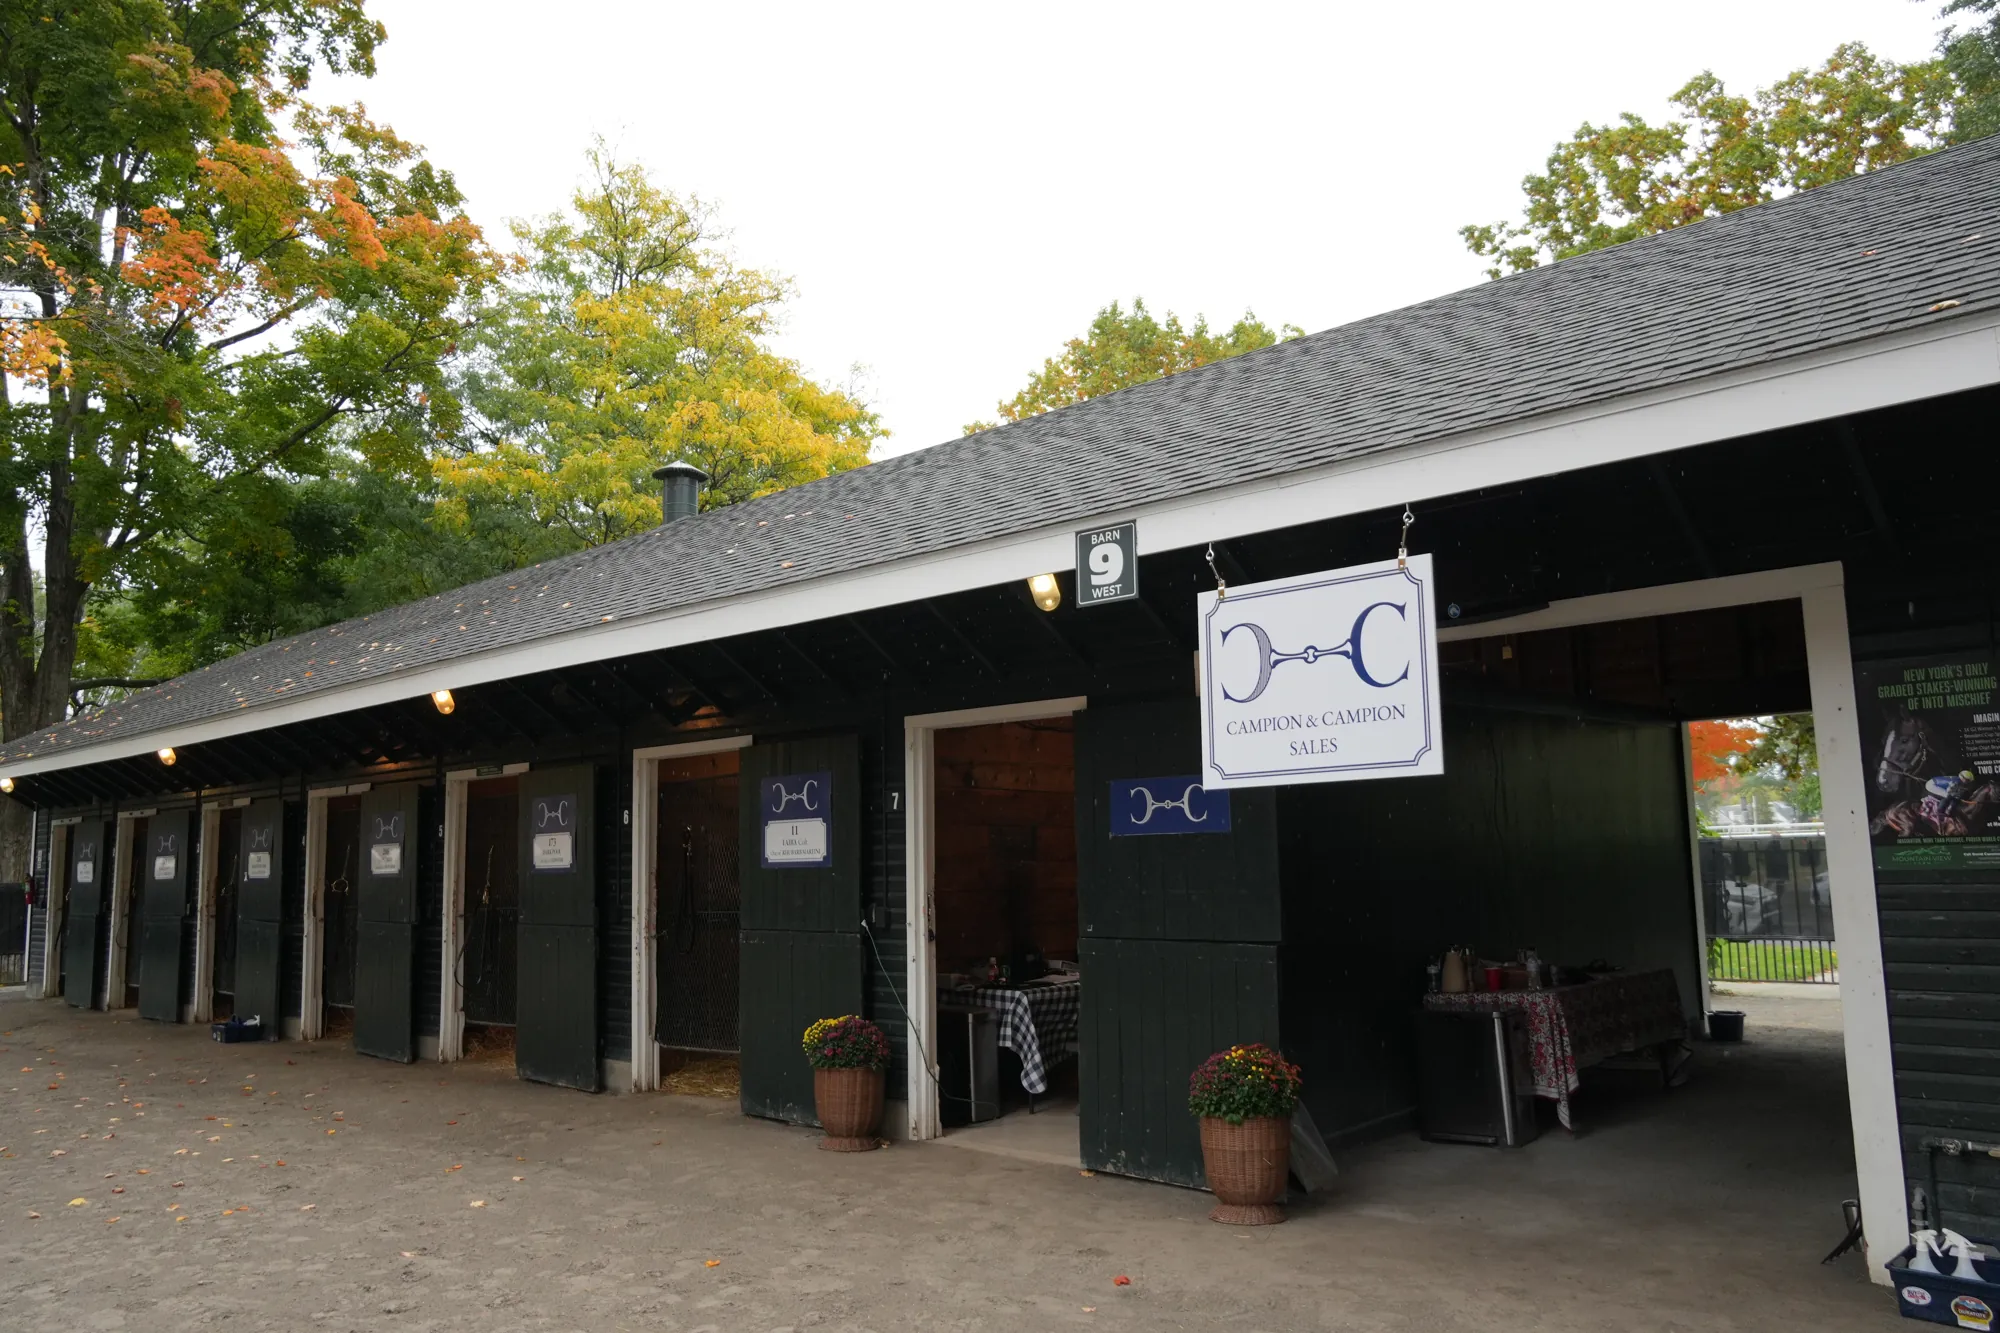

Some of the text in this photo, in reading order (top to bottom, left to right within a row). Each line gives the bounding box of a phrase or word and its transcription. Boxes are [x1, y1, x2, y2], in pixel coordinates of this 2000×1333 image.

[1091, 529, 1120, 544] BARN
[1089, 542, 1123, 585] 9
[1091, 584, 1122, 599] WEST
[1903, 662, 1988, 682] NEW YORK'S ONLY
[1878, 676, 1997, 698] GRADED STAKES-WINNING
[1908, 692, 1991, 710] OF INTO MISCHIEF
[1226, 704, 1406, 736] CAMPION & CAMPION
[1290, 738, 1338, 756] SALES
[1977, 765, 1993, 775] TWO
[891, 792, 899, 810] 7
[623, 809, 629, 825] 6
[438, 824, 443, 838] 5
